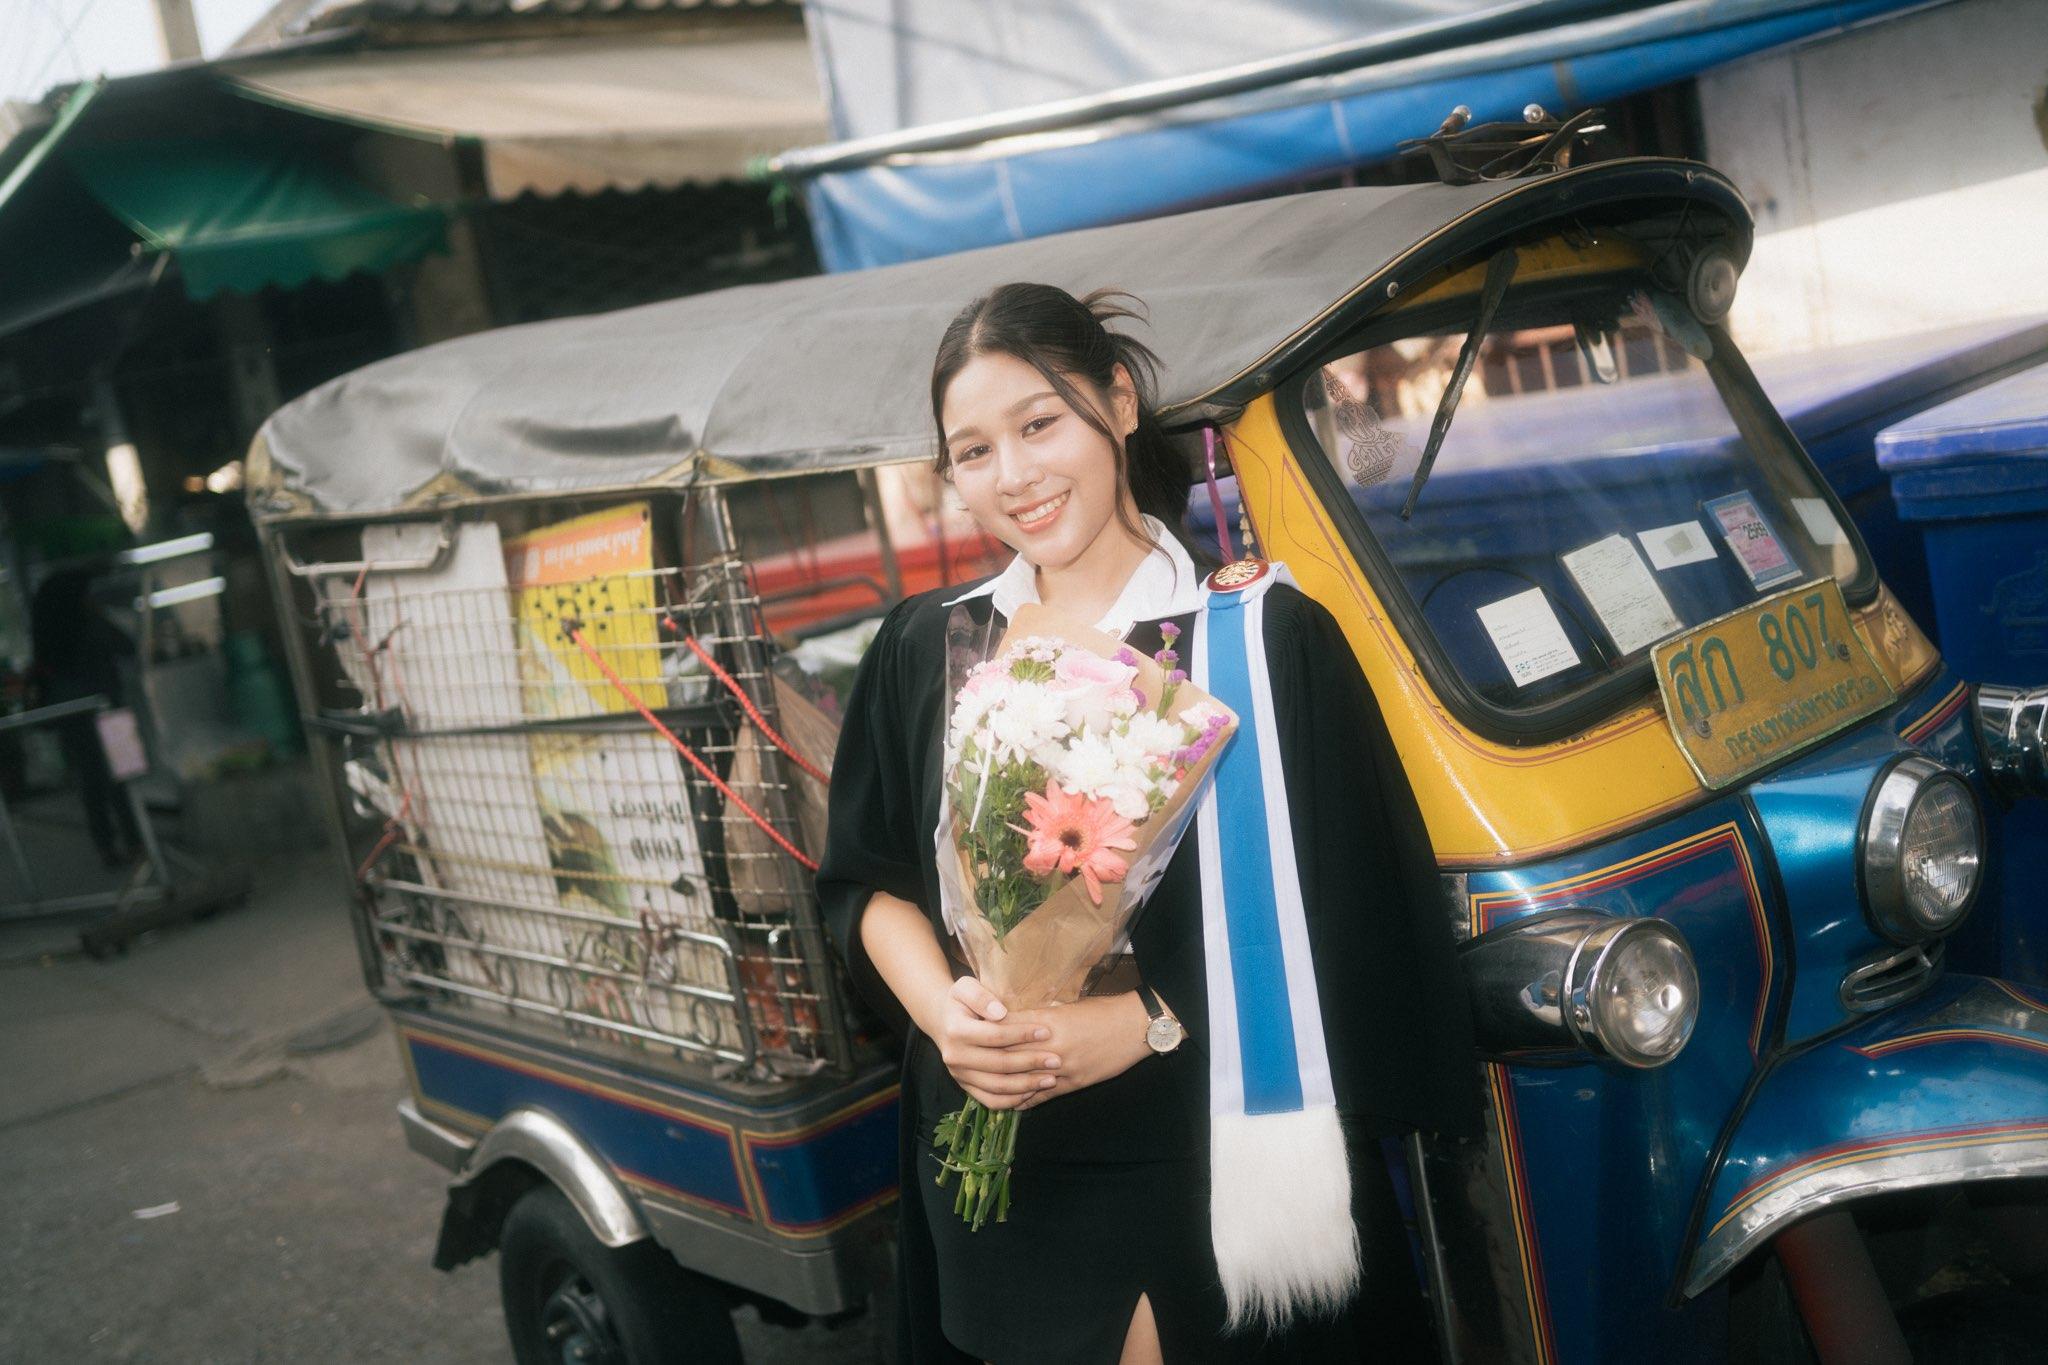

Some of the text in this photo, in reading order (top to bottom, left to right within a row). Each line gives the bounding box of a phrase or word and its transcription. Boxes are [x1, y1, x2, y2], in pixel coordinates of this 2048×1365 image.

[1758, 593, 1836, 682] 807
[1724, 677, 1863, 761] กรุงเทพมหานคร
